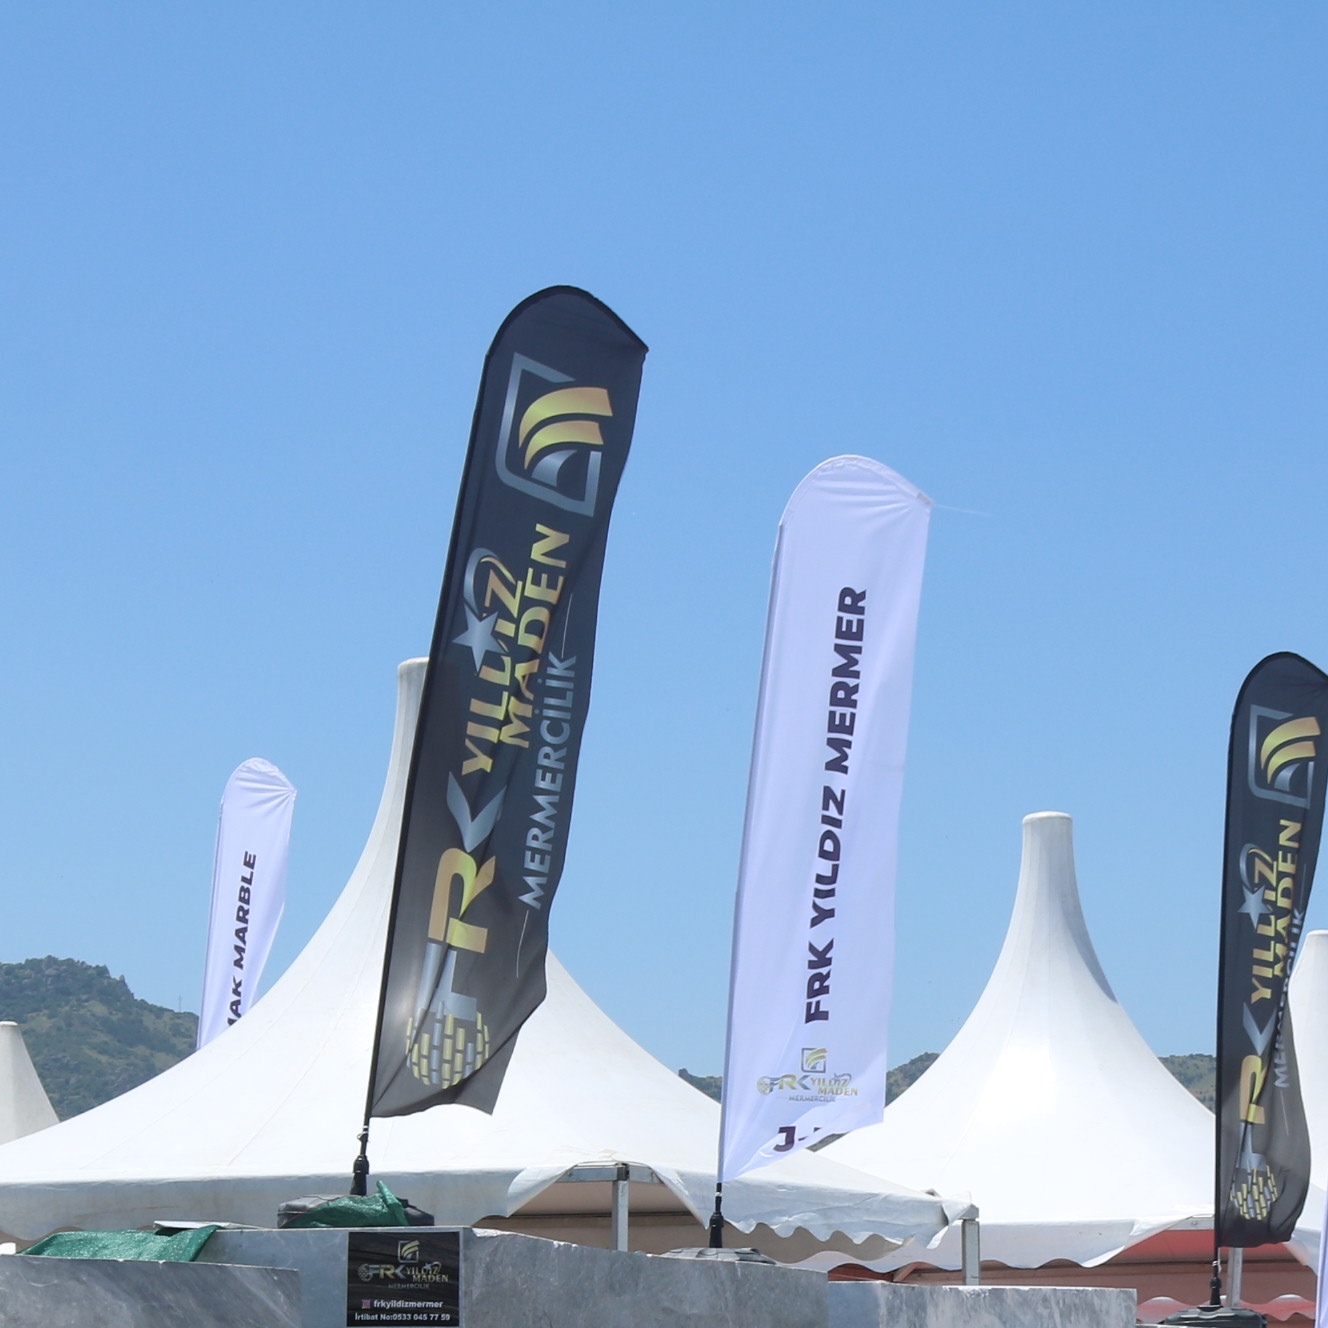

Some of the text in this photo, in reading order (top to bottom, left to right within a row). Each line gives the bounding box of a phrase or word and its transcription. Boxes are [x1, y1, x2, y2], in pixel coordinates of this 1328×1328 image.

[500, 522, 570, 748] MADEN
[518, 650, 577, 911] MERMERCİLİK
[804, 585, 868, 1025] FRK YILDIZ MERMER
[233, 850, 257, 970] MARBLE
[418, 770, 508, 1021] FRK
[1272, 818, 1303, 978] MADEN
[767, 1073, 812, 1094] FRK
[817, 1087, 859, 1096] MADEN
[367, 1264, 407, 1280] FRK
[373, 1299, 444, 1310] frkyildizmermer
[412, 1274, 449, 1283] MADEN
[413, 1313, 428, 1321] 045
[429, 1313, 440, 1321] 77
[440, 1313, 451, 1321] 59
